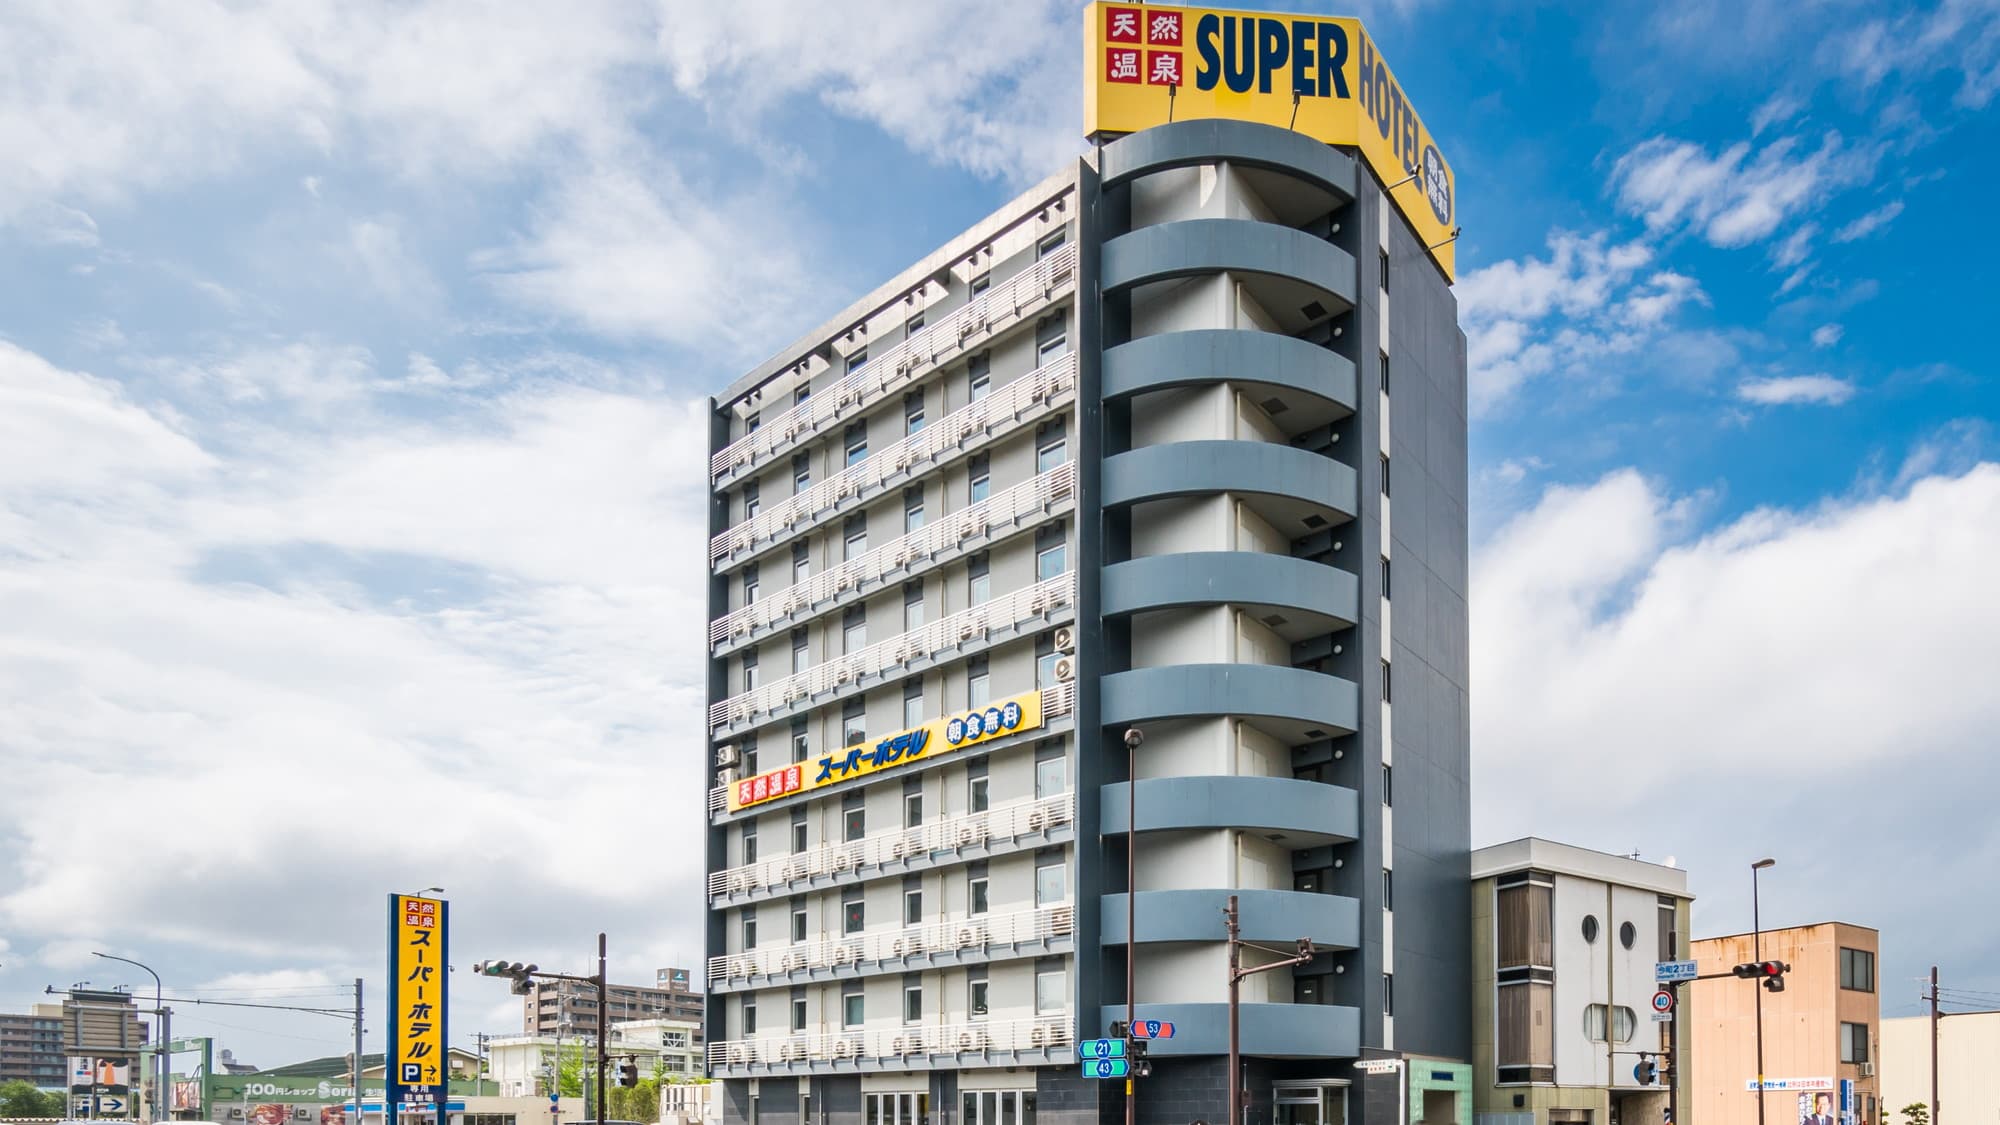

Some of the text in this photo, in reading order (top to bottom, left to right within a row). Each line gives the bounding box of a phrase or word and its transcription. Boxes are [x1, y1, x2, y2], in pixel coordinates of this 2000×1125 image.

[1112, 13, 1178, 40] 天然
[1111, 52, 1180, 82] 温泉
[1196, 13, 1351, 99] SUPER
[1358, 27, 1423, 195] HOTEL
[741, 704, 1018, 801] 天然温泉 スーパーホテル 朝食無料
[407, 929, 434, 1058] スーパーホテル
[1656, 996, 1668, 1006] 40
[1148, 1023, 1158, 1033] 53
[1097, 1043, 1108, 1055] 21
[405, 1064, 419, 1080] P
[1098, 1063, 1109, 1073] 43
